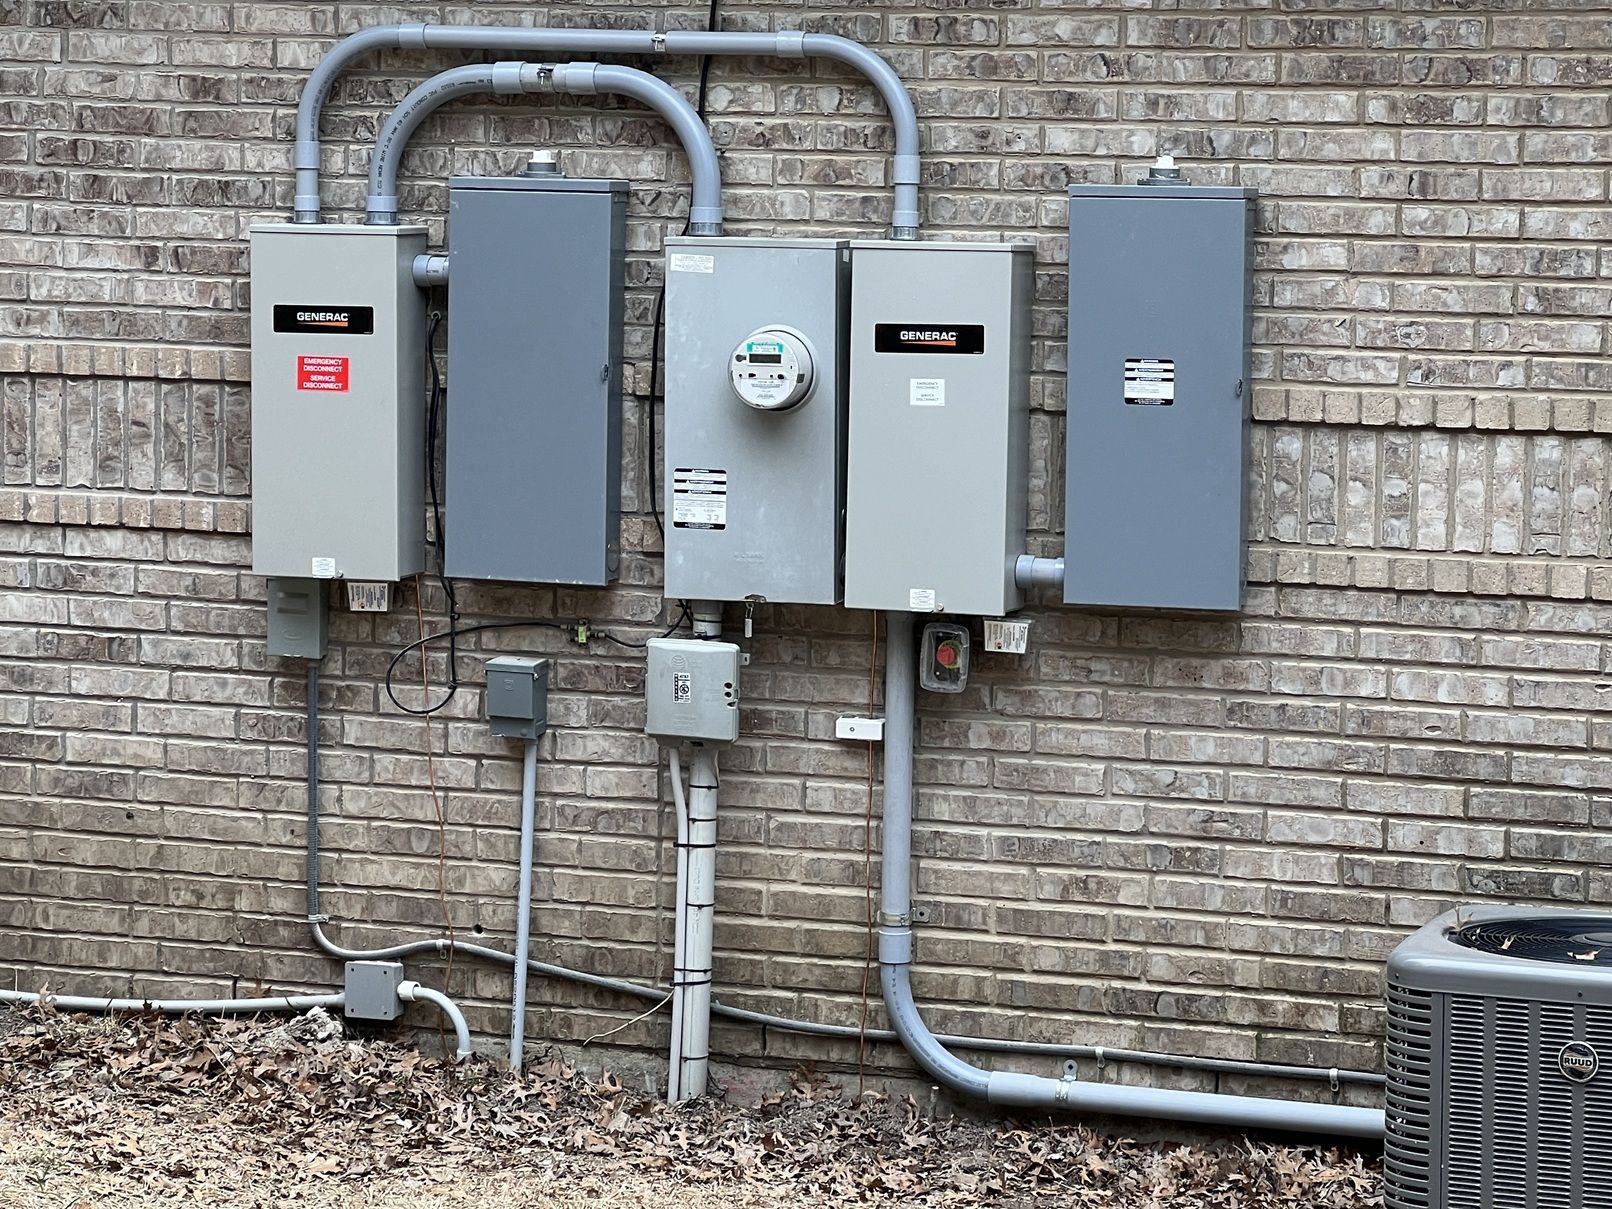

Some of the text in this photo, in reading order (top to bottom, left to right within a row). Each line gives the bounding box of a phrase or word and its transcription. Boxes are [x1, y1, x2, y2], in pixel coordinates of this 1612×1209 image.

[297, 312, 348, 321] GENERAC
[900, 331, 957, 340] GENERAC
[1564, 1057, 1592, 1067] RUUD
